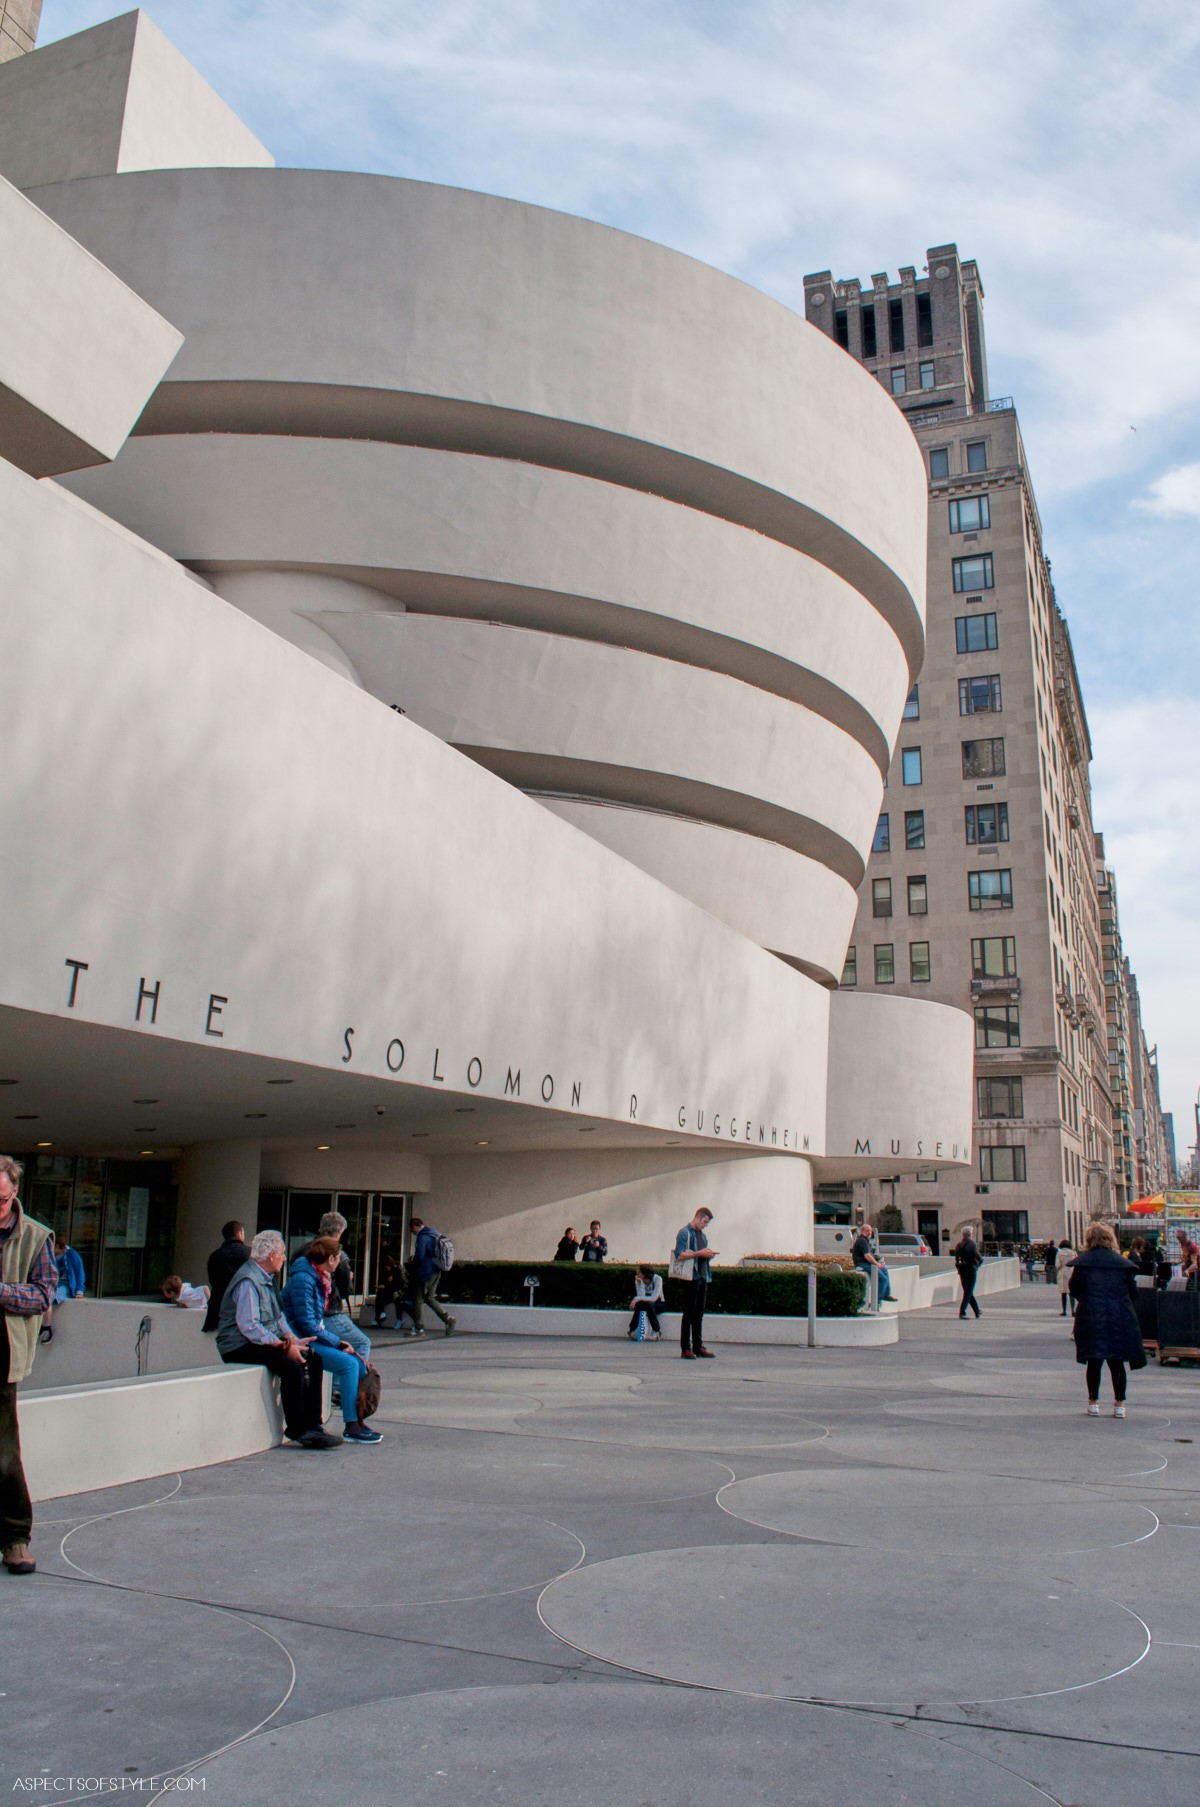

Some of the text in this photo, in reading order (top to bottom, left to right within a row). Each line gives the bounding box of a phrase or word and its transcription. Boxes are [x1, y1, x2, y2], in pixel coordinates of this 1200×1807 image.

[65, 958, 229, 1038] THE
[342, 1027, 582, 1109] SOLOMON
[629, 1093, 638, 1119] R
[677, 1105, 810, 1152] GUGGENHEIM
